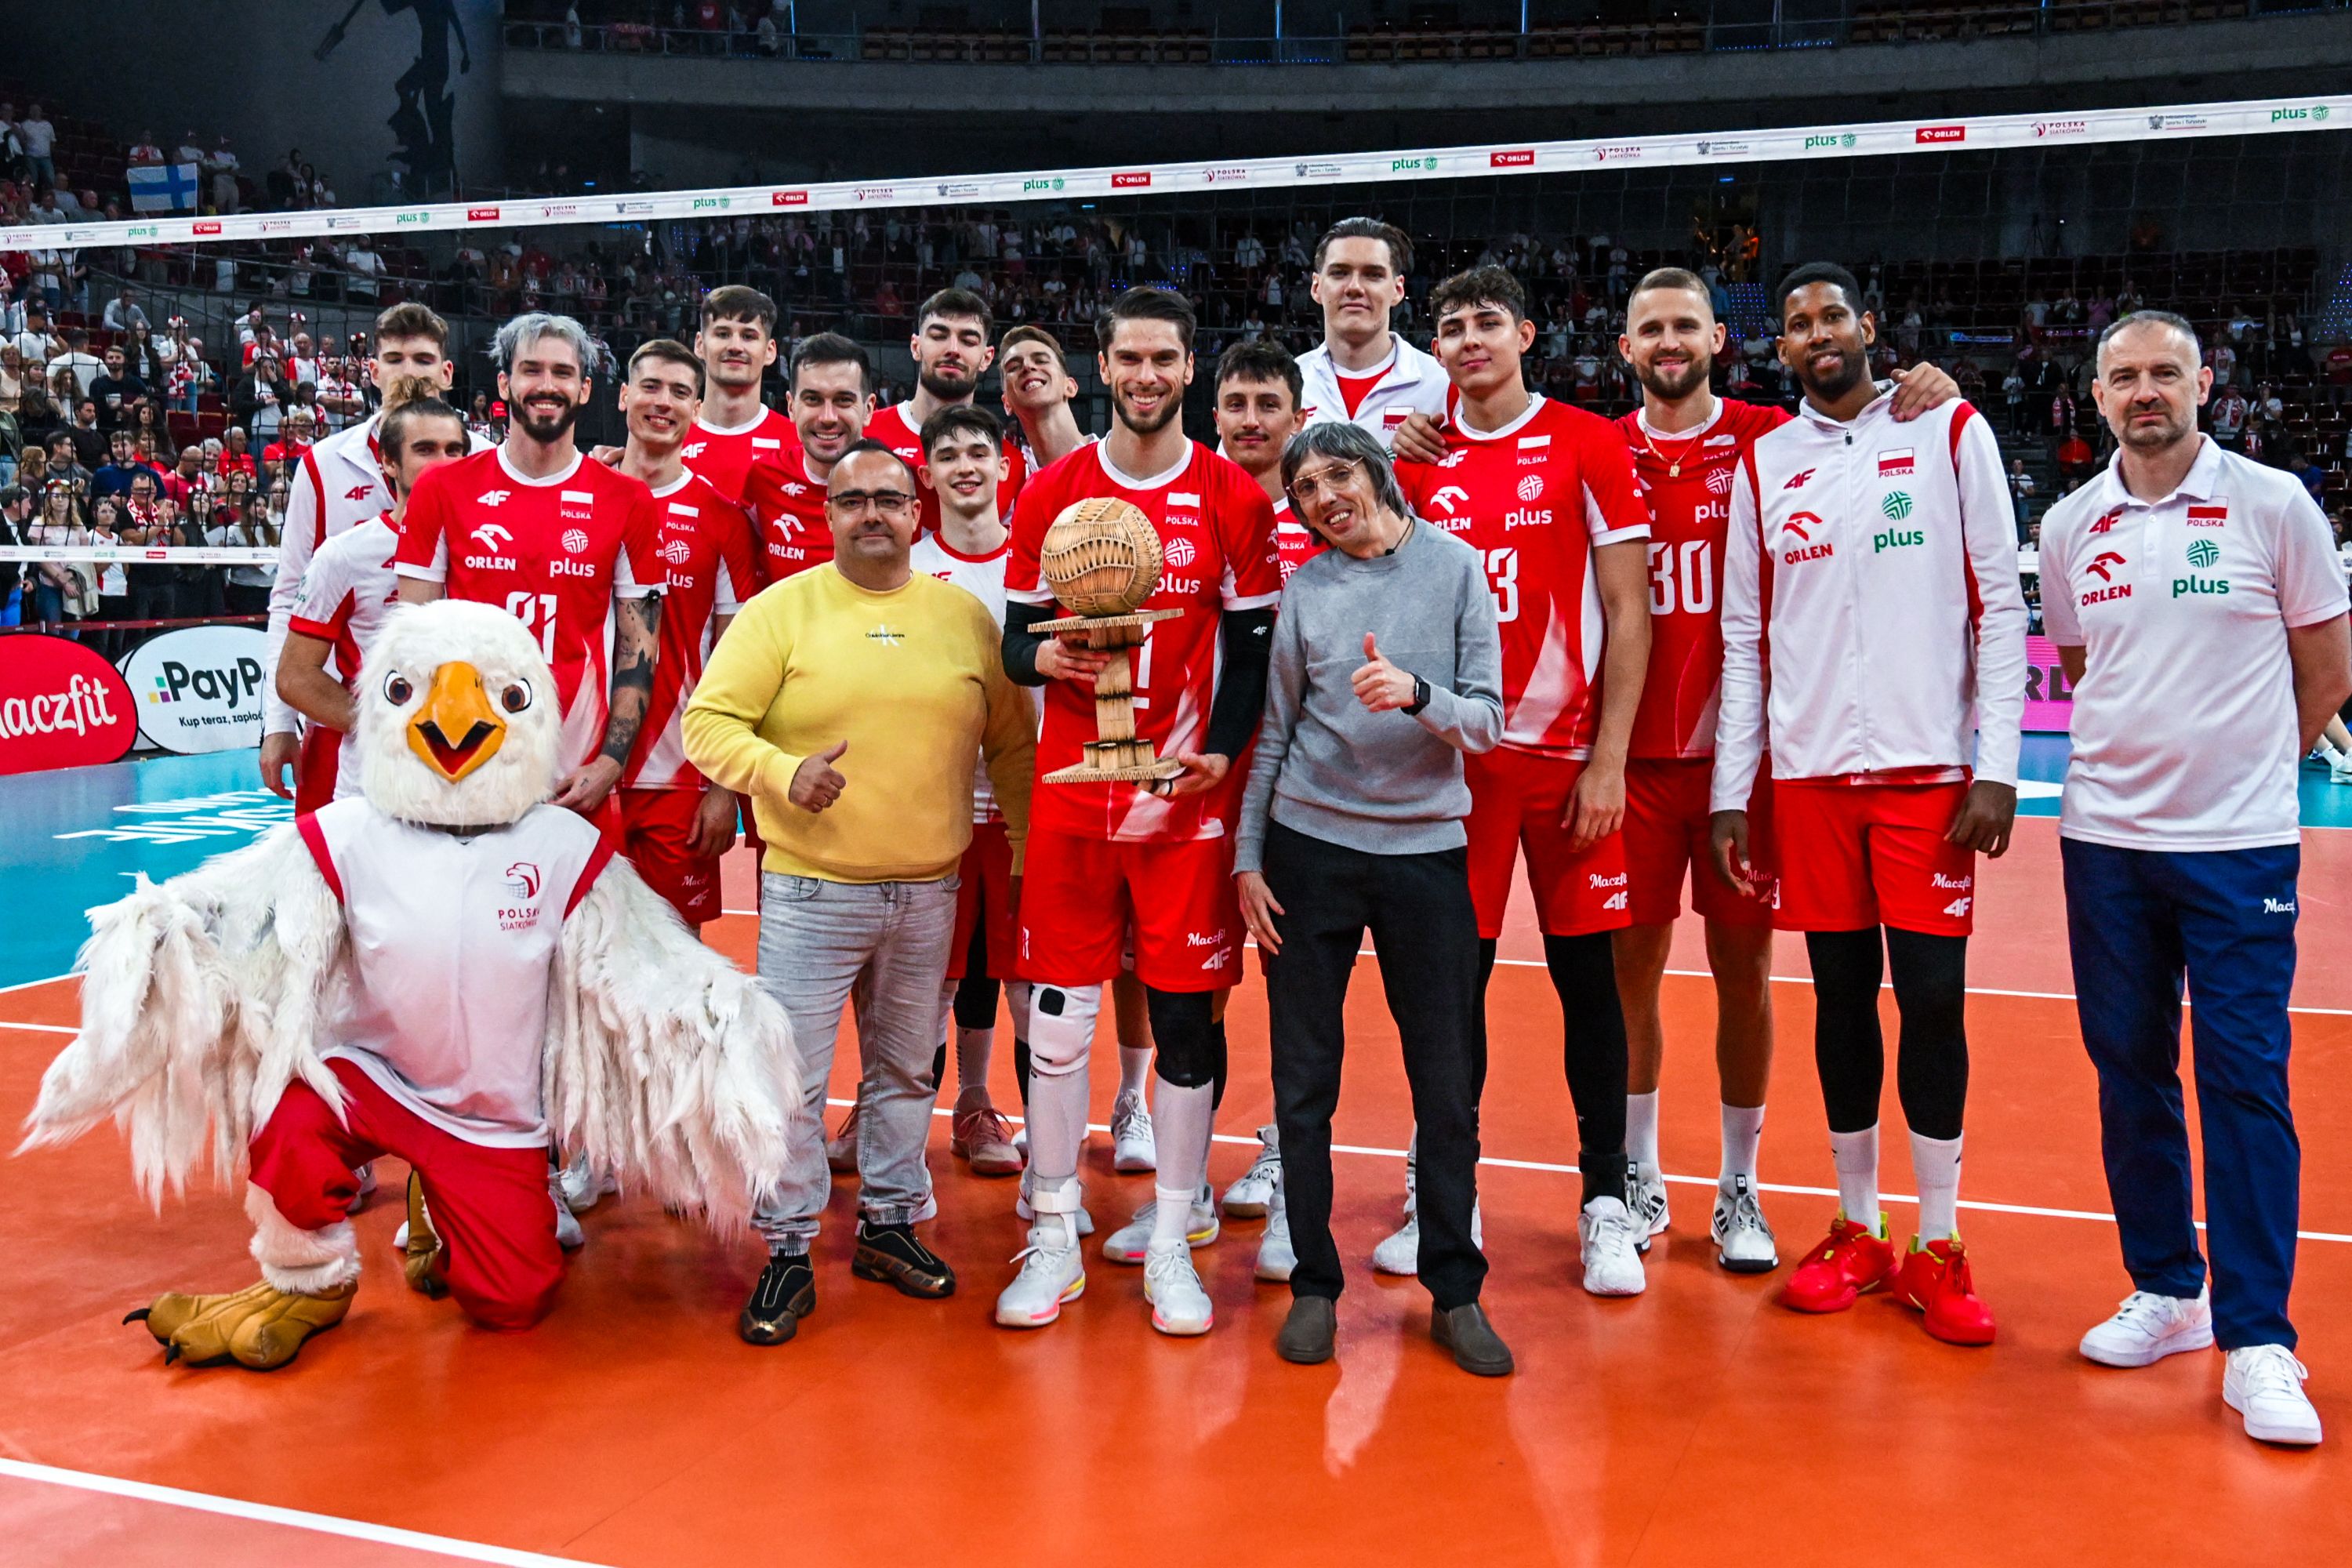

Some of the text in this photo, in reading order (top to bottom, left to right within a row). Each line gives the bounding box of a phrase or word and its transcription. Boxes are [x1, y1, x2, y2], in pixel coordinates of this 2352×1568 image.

[2271, 107, 2307, 122] plus
[1934, 129, 1960, 138] ORLEN
[1806, 136, 1837, 149] plus
[1392, 158, 1421, 172] plus
[1024, 177, 1049, 191] plus
[1126, 175, 1148, 183] ORLEN
[694, 198, 717, 211] plus
[397, 213, 418, 225] plus
[128, 226, 147, 238] plus
[681, 442, 707, 459] 4F
[1517, 456, 1548, 466] POLSKA
[1784, 468, 1817, 489] 4F
[1878, 469, 1914, 478] POLSKA
[345, 485, 374, 500] 4F
[780, 481, 807, 497] 4F
[477, 490, 511, 506] 4F
[561, 511, 592, 522] POLSKA
[1505, 507, 1552, 531] plus
[1695, 499, 1730, 523] plu
[666, 521, 695, 532] POLSKA
[1165, 516, 1199, 526] POLSKA
[1434, 517, 1472, 532] RLEN
[2089, 510, 2123, 533] 4F
[1874, 528, 1925, 554] plus
[768, 543, 804, 561] ORLEN
[1784, 543, 1833, 564] ORLEN
[465, 556, 516, 571] ORLEN
[550, 557, 595, 578] plus
[666, 568, 694, 588] lus
[1646, 539, 1713, 615] 30
[2172, 575, 2230, 598] plus
[2082, 584, 2132, 607] ORLEN
[1253, 626, 1268, 635] 4F
[162, 657, 263, 709] PayP
[2024, 665, 2073, 701] RL
[0, 673, 117, 739] aczfit
[179, 714, 201, 729] Kup
[201, 713, 231, 725] teraz,
[1602, 891, 1628, 909] 4F
[1944, 897, 1971, 916] 4F
[1202, 946, 1232, 970] 4F
